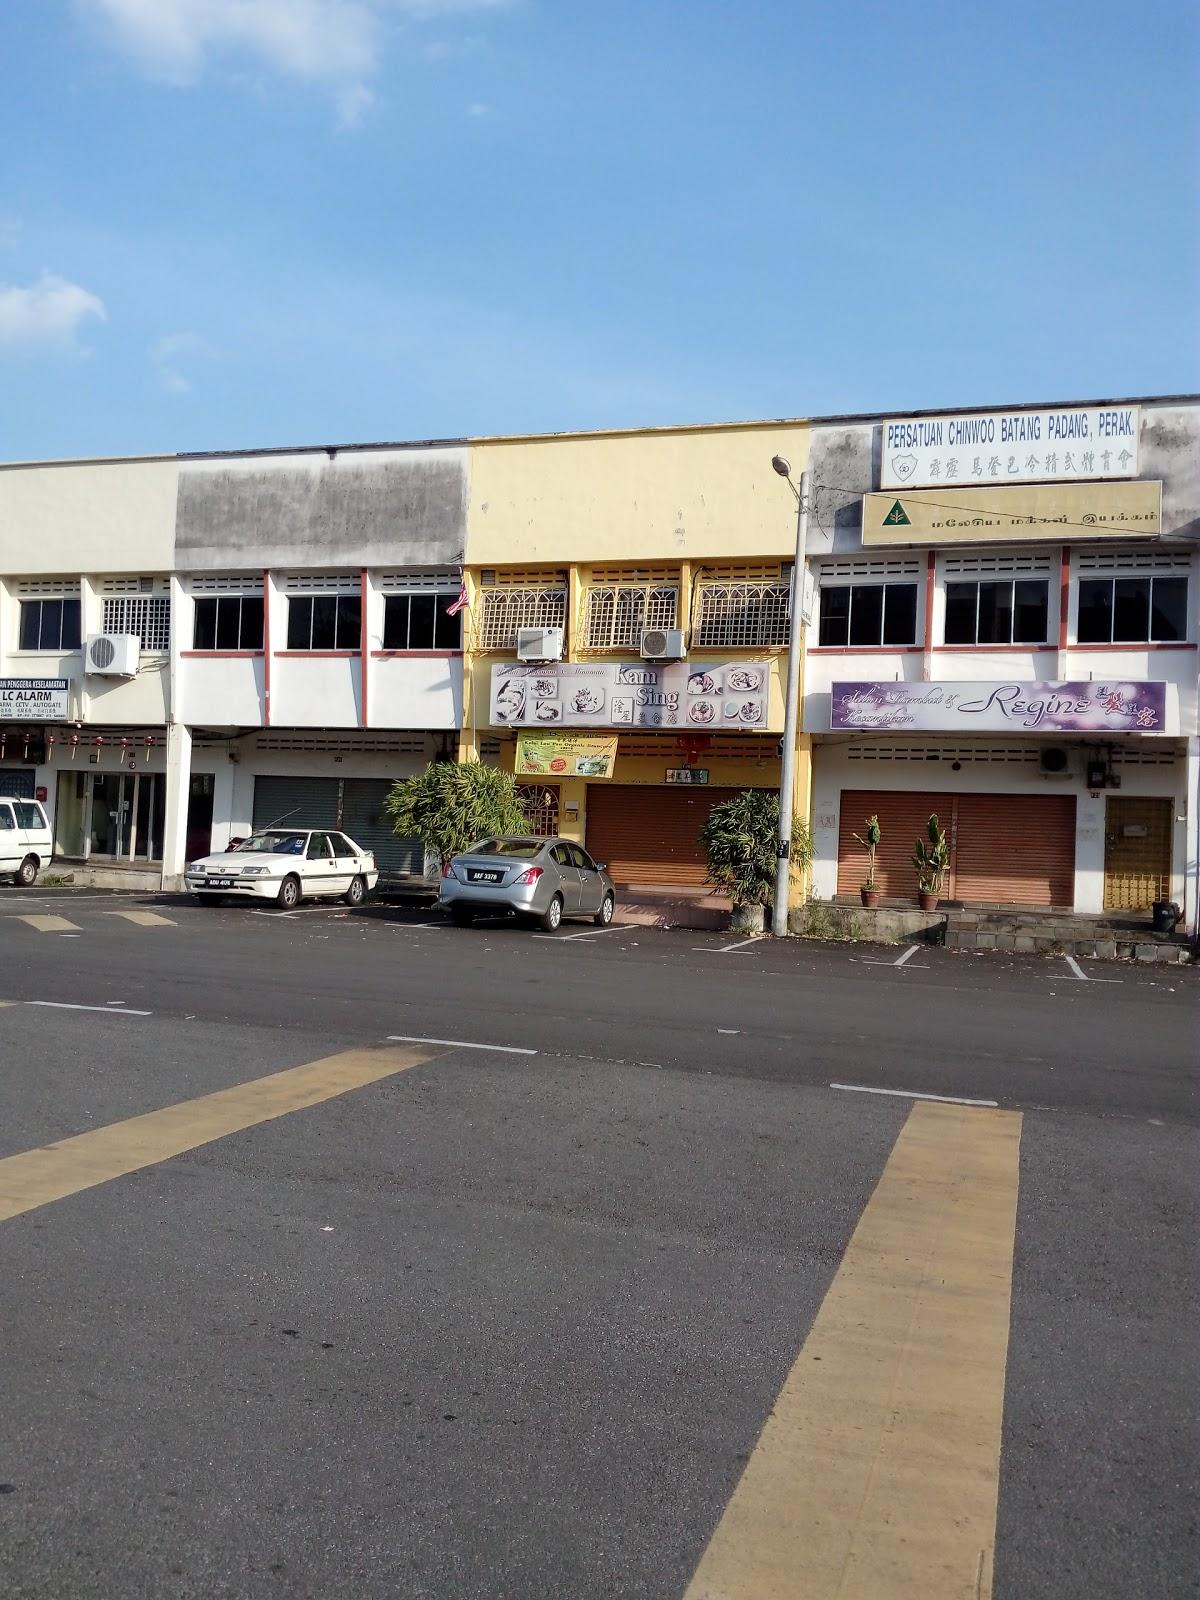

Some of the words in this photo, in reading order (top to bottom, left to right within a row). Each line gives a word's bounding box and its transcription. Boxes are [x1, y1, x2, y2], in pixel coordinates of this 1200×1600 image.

[887, 423, 943, 449] PERSATUAN
[948, 418, 995, 445] CHINWOO
[1001, 416, 1041, 442] BATANG
[1049, 413, 1093, 442] PADANG,
[33, 680, 66, 688] KESELAMATAN
[616, 668, 657, 686] Kam
[2, 691, 14, 701] LC
[16, 691, 52, 701] ALARM
[636, 688, 679, 711] Sing
